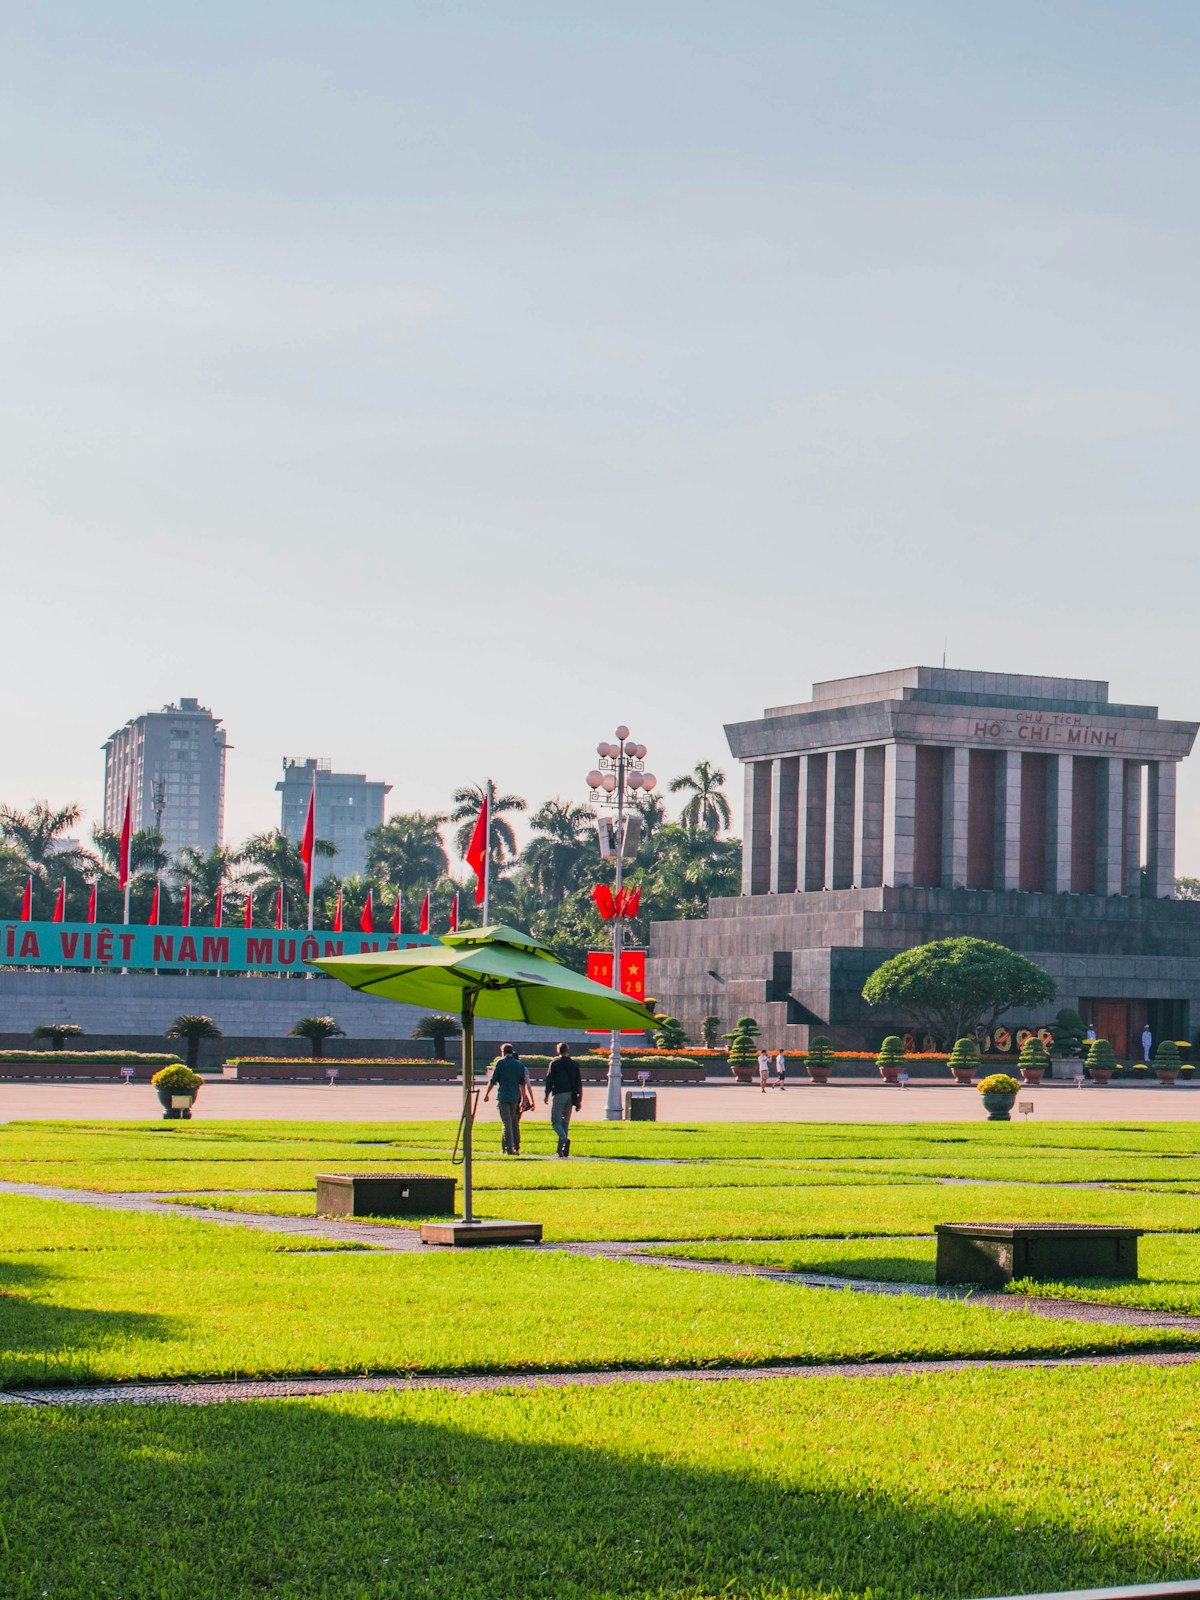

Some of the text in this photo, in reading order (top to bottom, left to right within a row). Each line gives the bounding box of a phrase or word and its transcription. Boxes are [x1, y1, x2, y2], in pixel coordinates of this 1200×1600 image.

[0, 925, 41, 959] ĨA
[60, 928, 136, 965] VIỆT
[153, 935, 230, 964] NAM
